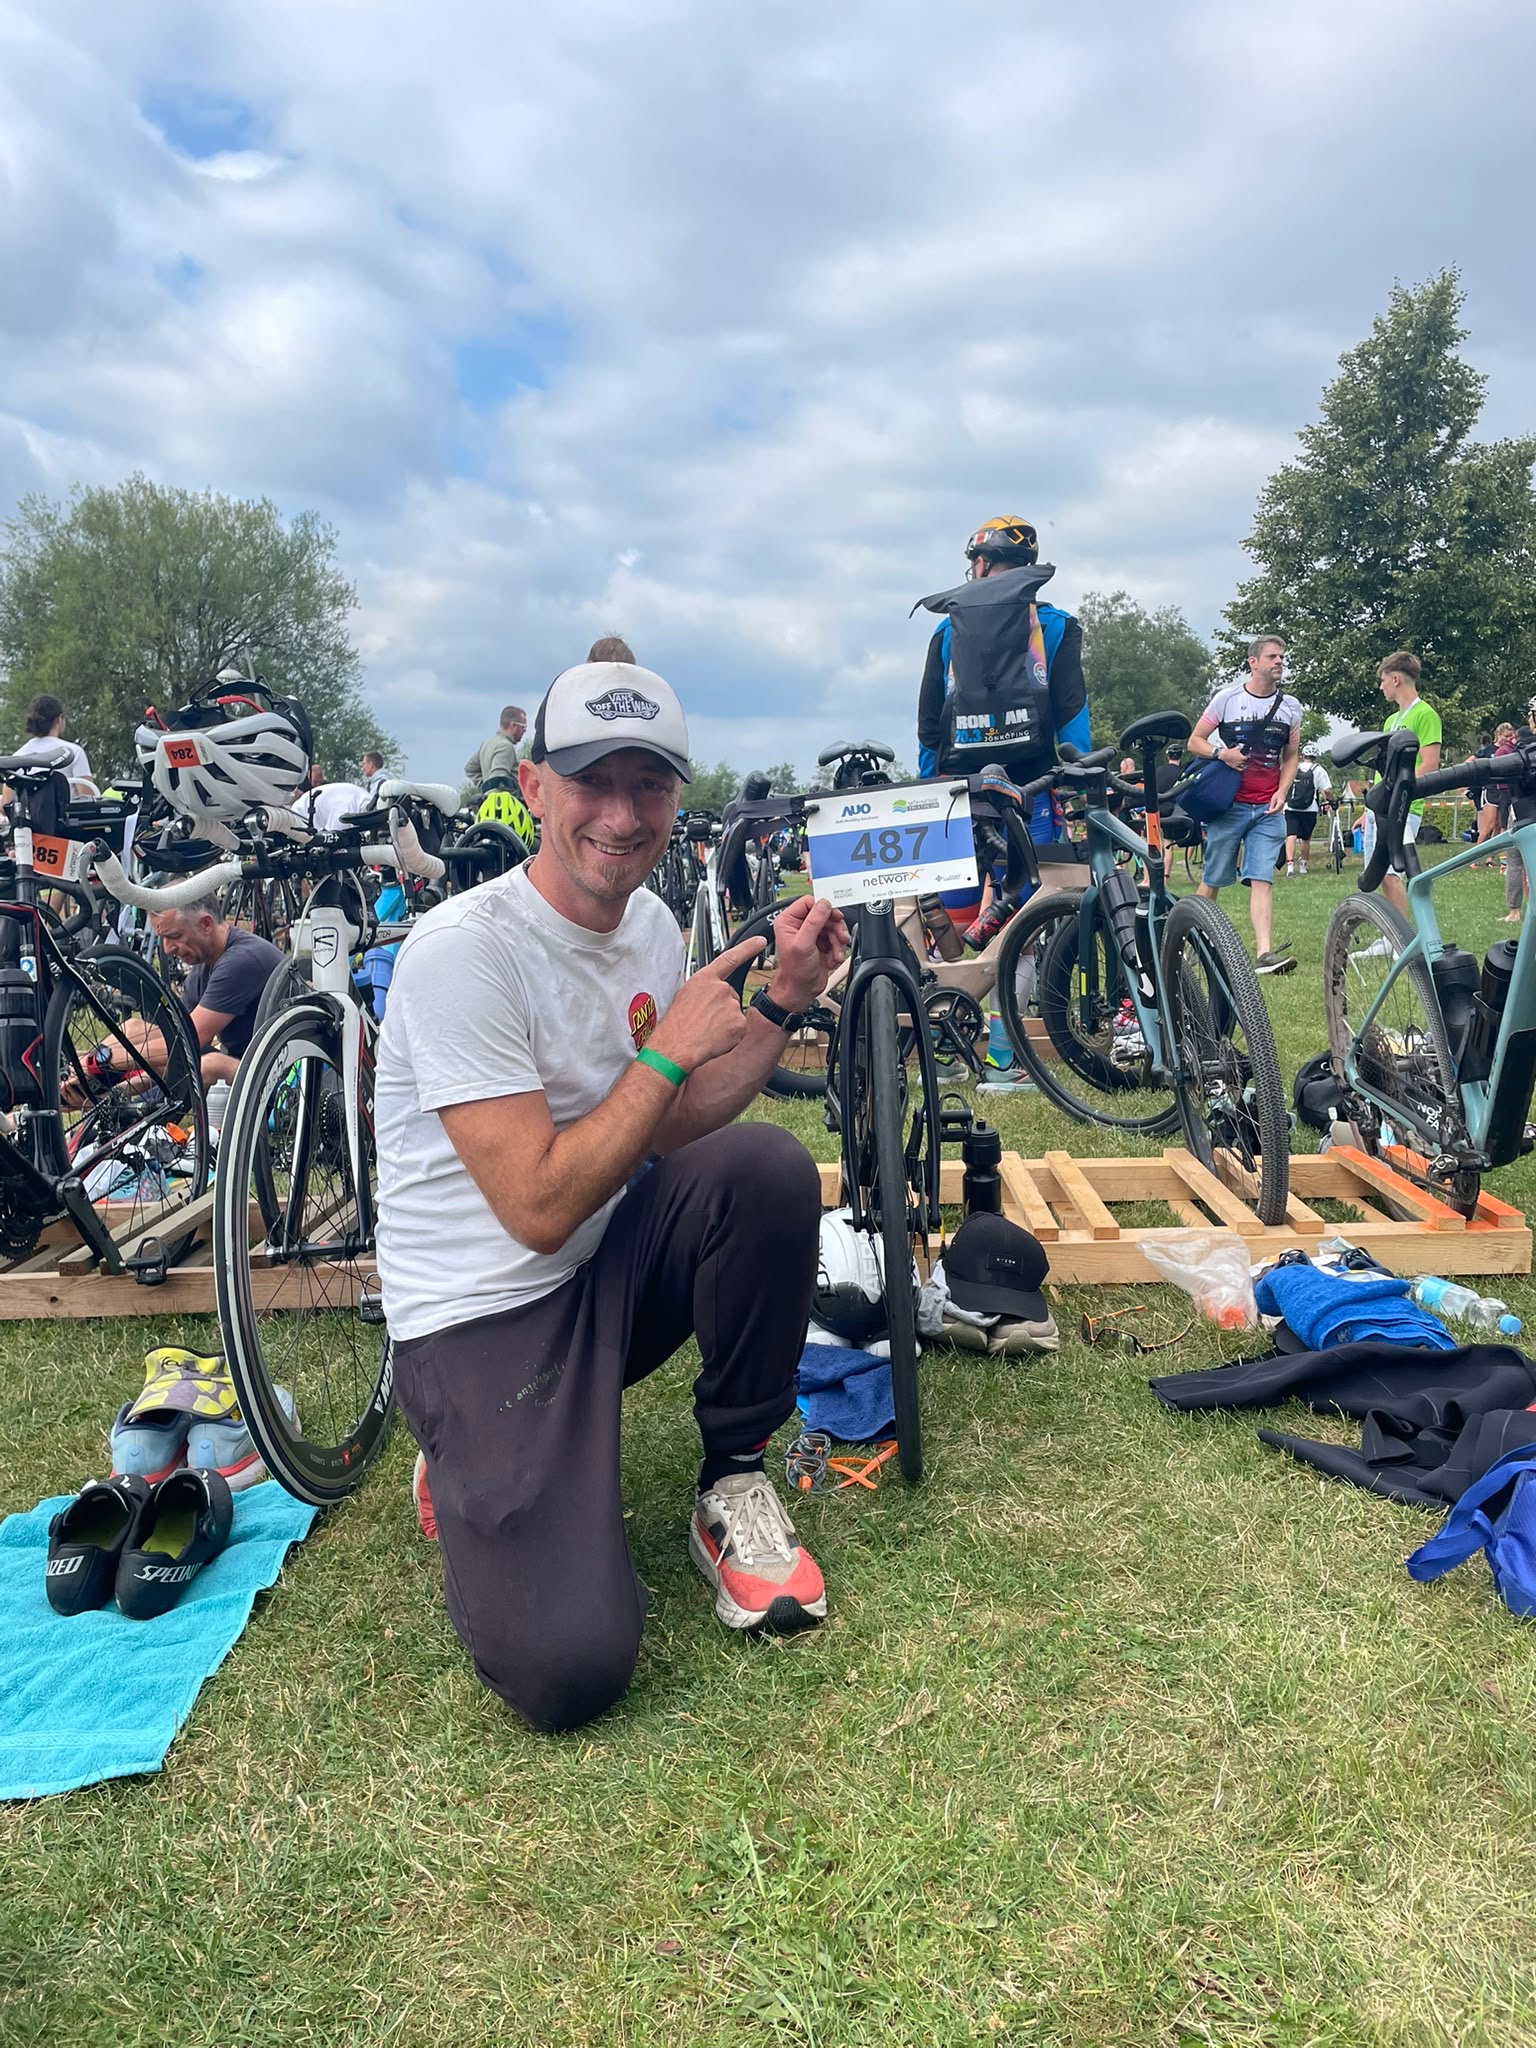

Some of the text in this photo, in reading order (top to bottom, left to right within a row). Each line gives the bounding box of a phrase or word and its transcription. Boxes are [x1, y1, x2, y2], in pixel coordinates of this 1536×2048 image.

[608, 692, 635, 702] VANS
[613, 701, 632, 713] THE
[171, 748, 194, 760] 284
[841, 803, 872, 818] AUO
[851, 826, 929, 866] 487
[32, 845, 59, 865] 85
